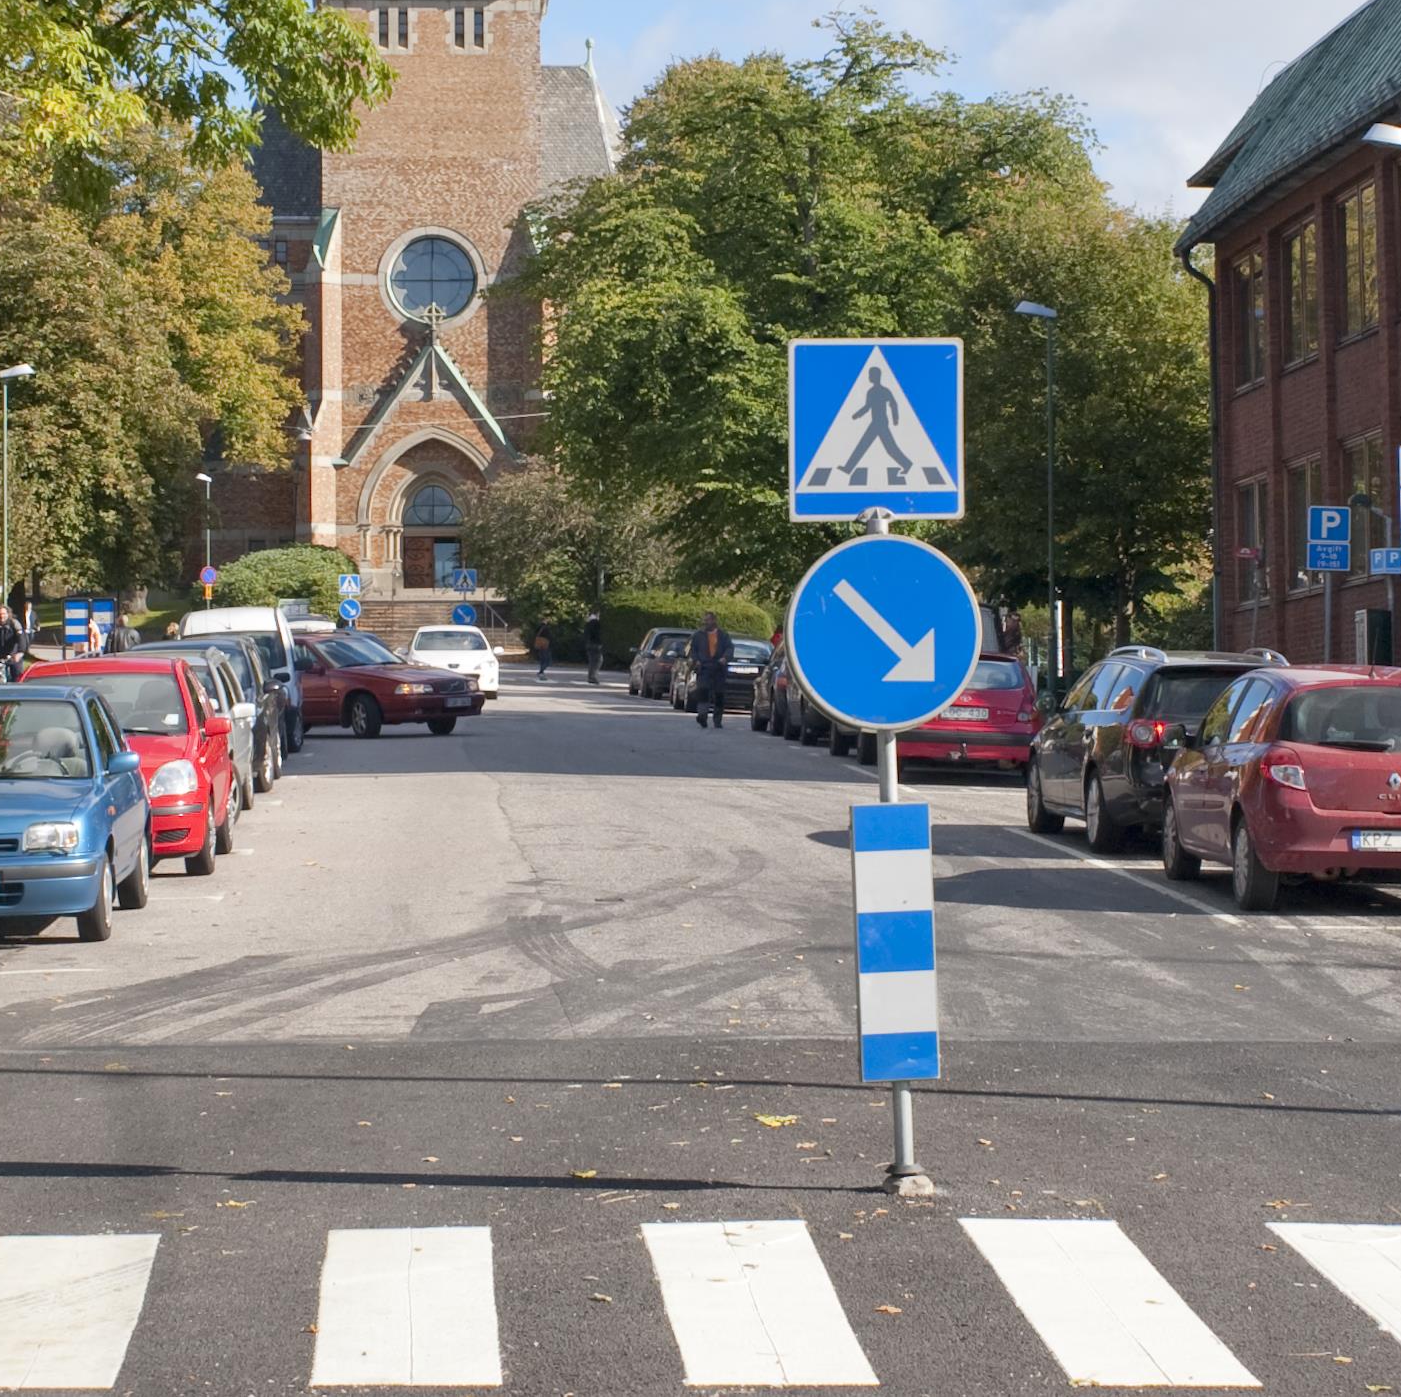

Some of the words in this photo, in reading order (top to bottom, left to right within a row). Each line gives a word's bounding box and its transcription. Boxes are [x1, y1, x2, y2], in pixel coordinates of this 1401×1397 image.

[1321, 510, 1341, 539] P
[1316, 545, 1342, 554] Avgift
[1389, 552, 1399, 563] P
[1362, 832, 1392, 847] KPZ
